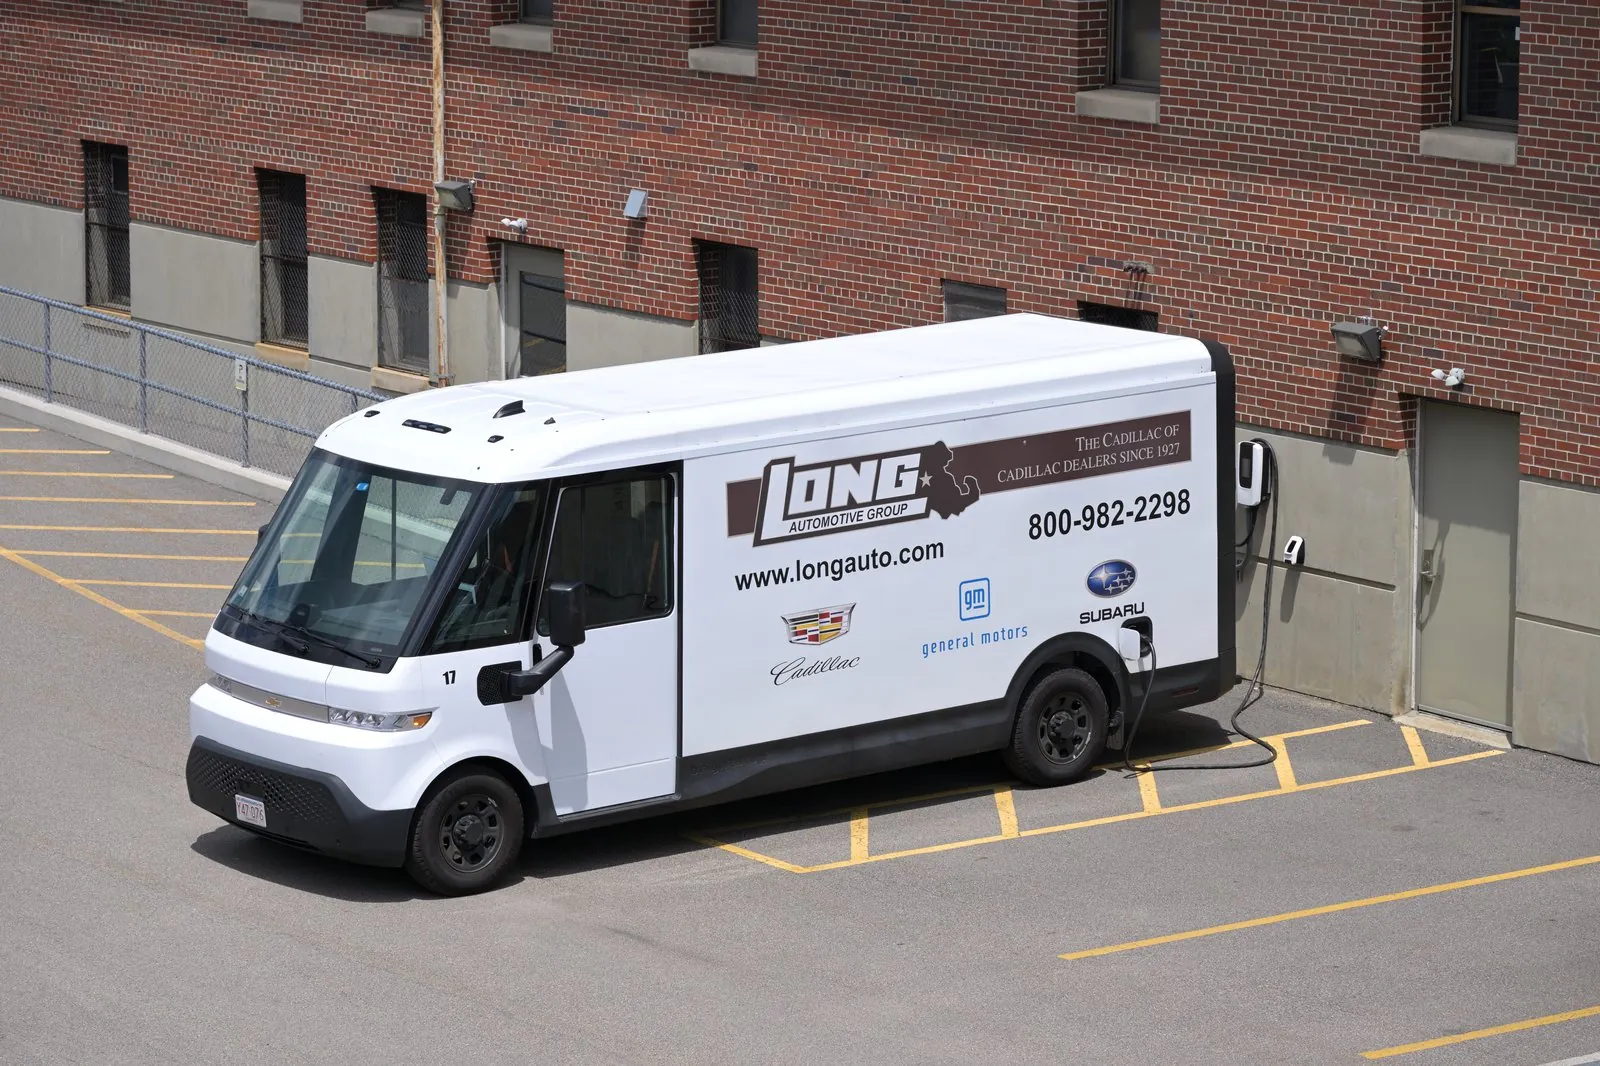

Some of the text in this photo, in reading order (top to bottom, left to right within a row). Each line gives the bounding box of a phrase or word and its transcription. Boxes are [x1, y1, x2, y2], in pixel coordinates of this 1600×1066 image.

[1164, 424, 1180, 437] OF
[997, 442, 1180, 483] CADILLAC DEALERS SINCE 1927
[760, 453, 925, 540] LONG
[789, 503, 908, 533] AUTOMOTIVE GROUP
[1028, 488, 1190, 540] 800-982-2298
[734, 541, 944, 591] www.longauto.com
[964, 586, 985, 610] gm
[1080, 602, 1144, 624] SUBARU
[922, 625, 1028, 658] general motors
[443, 670, 456, 685] 17
[770, 656, 860, 686] Cadillac
